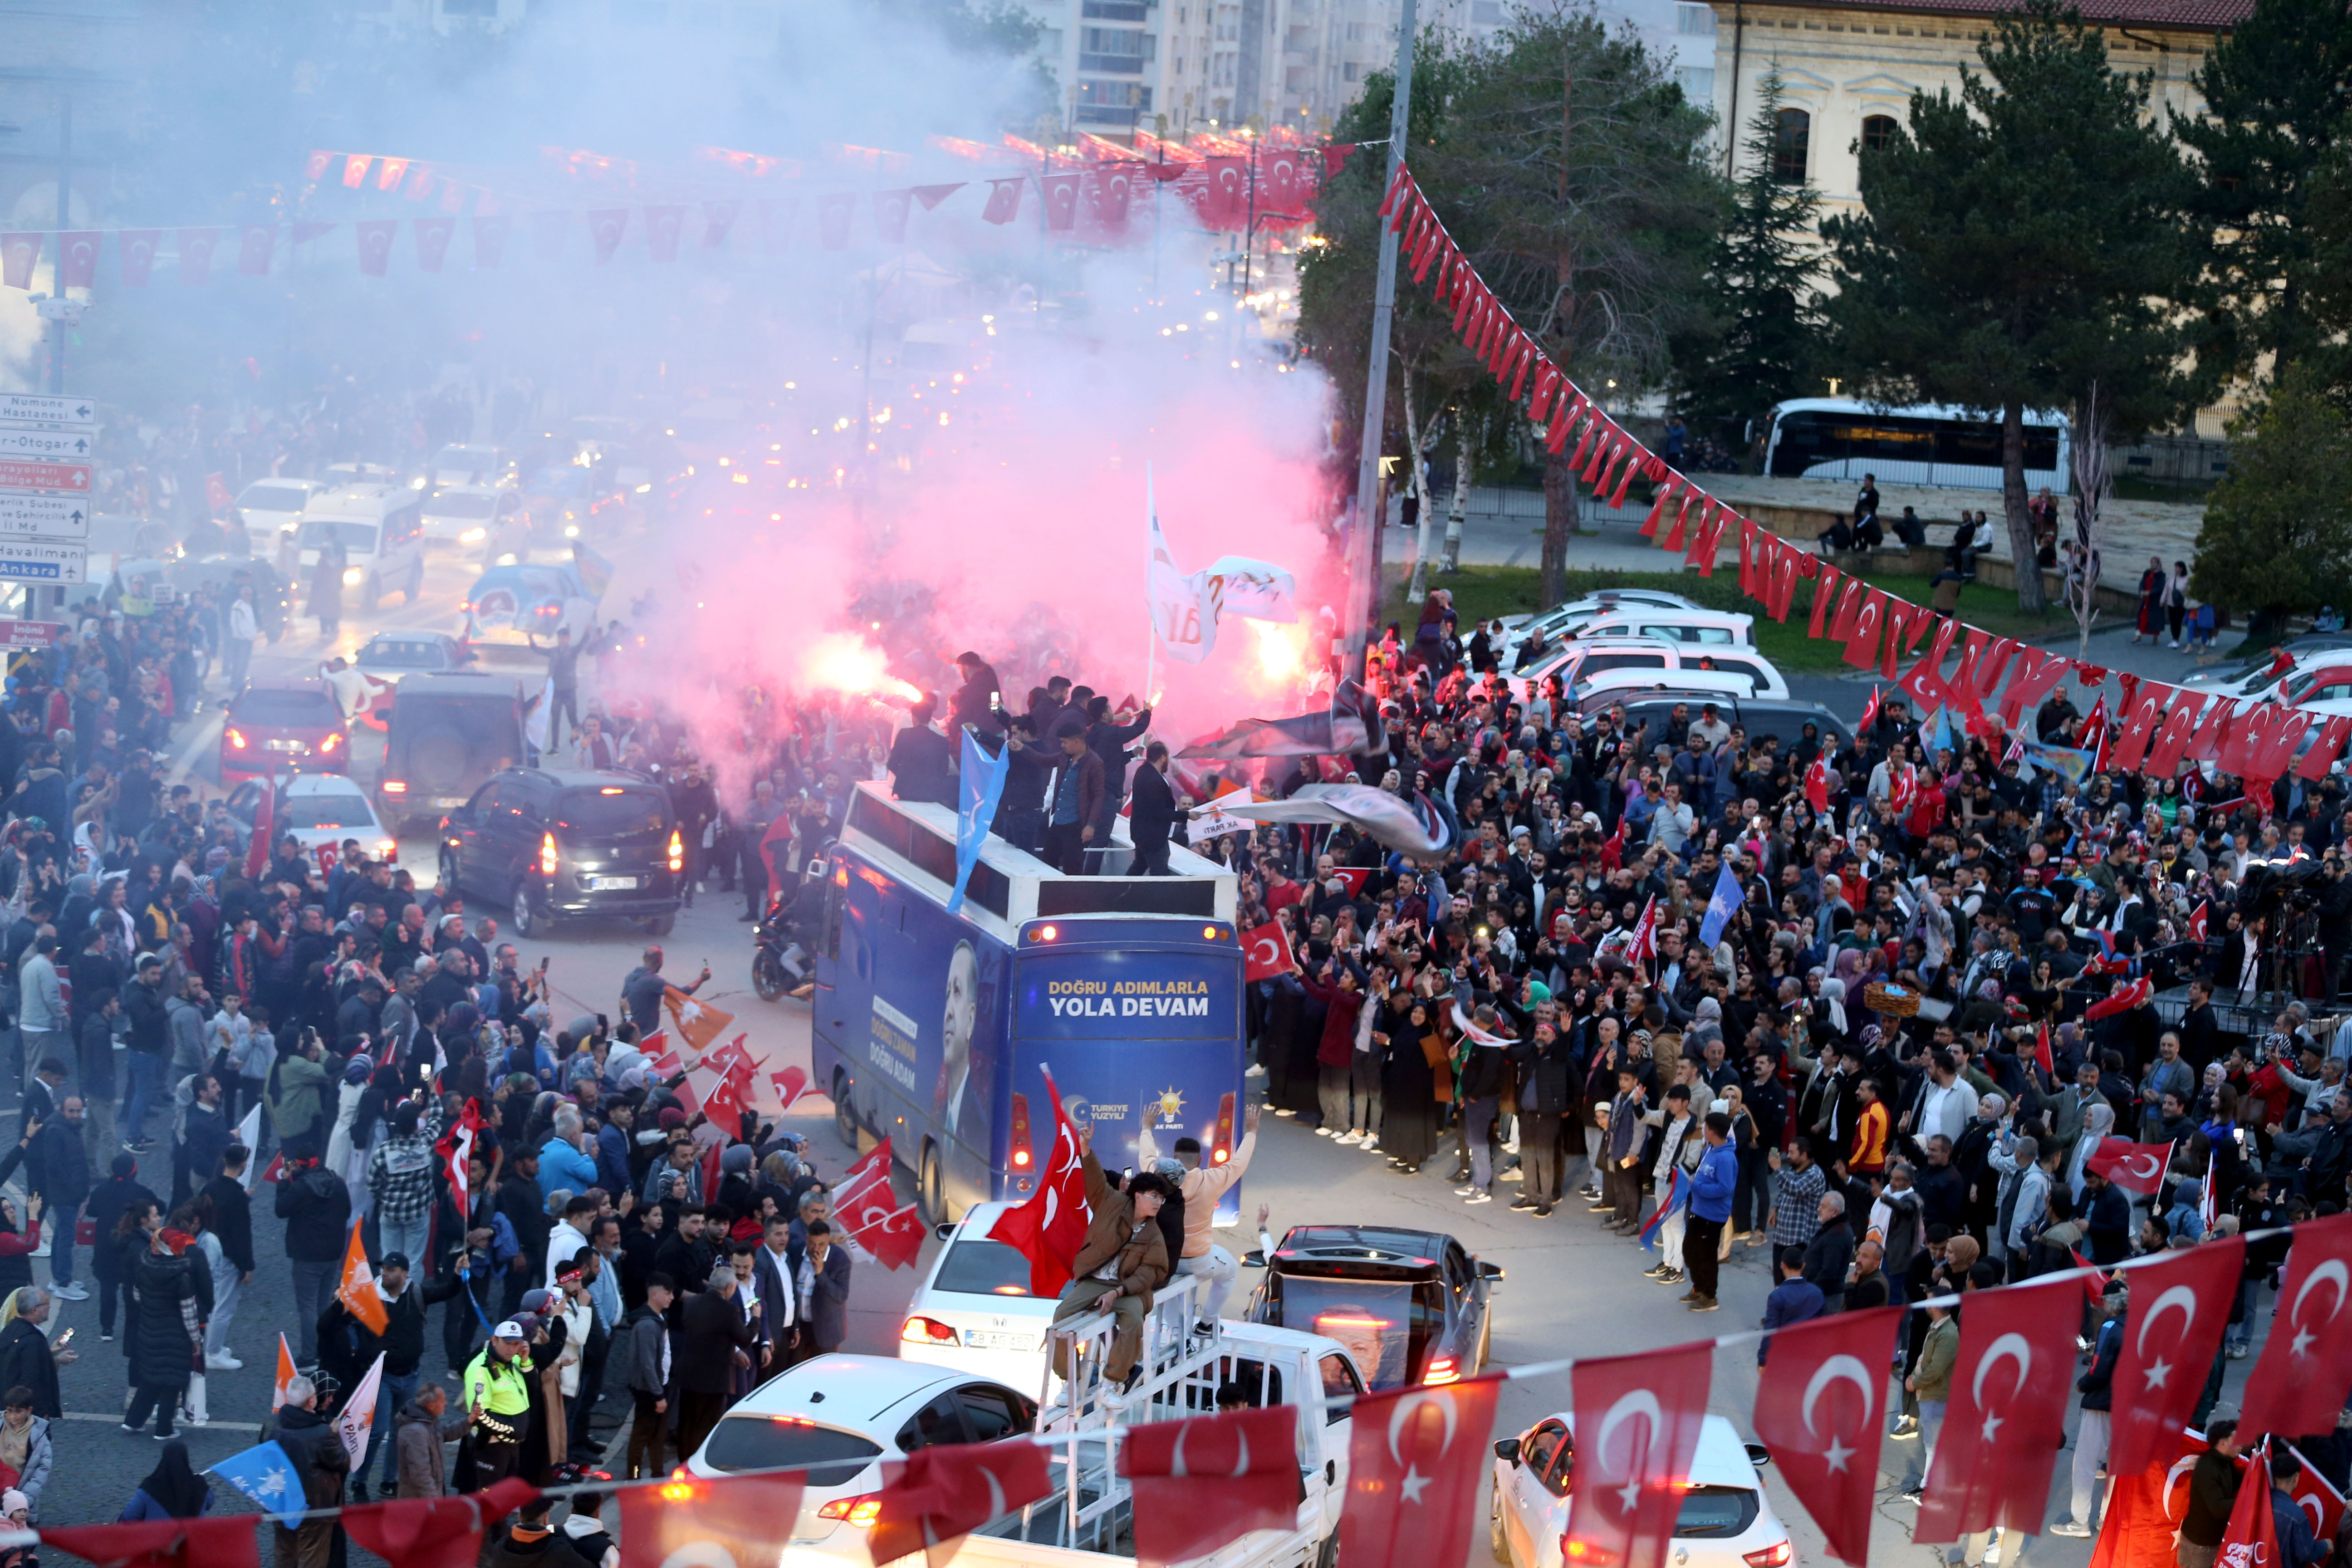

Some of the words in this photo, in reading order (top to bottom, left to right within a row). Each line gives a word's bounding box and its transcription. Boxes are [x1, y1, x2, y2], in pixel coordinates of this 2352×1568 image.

[12, 397, 64, 407] Numune
[4, 407, 68, 420] Hastanesi
[0, 466, 58, 475] rayolları
[0, 563, 56, 576] Ankara
[14, 625, 45, 634] İnönü
[10, 635, 48, 645] Bulvarı
[1049, 980, 1107, 994] DOĞRU
[1112, 981, 1209, 994] ADIMLARLA
[1049, 997, 1116, 1016] YOLA
[1122, 997, 1209, 1016] DEVAM
[871, 1016, 893, 1046] DOĞRU
[870, 1041, 894, 1075] DOĞRU
[893, 1060, 915, 1092] ADAM
[972, 1333, 985, 1344] 58
[990, 1335, 1006, 1345] AG
[344, 1423, 359, 1455] PARTİ
[230, 1476, 250, 1492] AK
